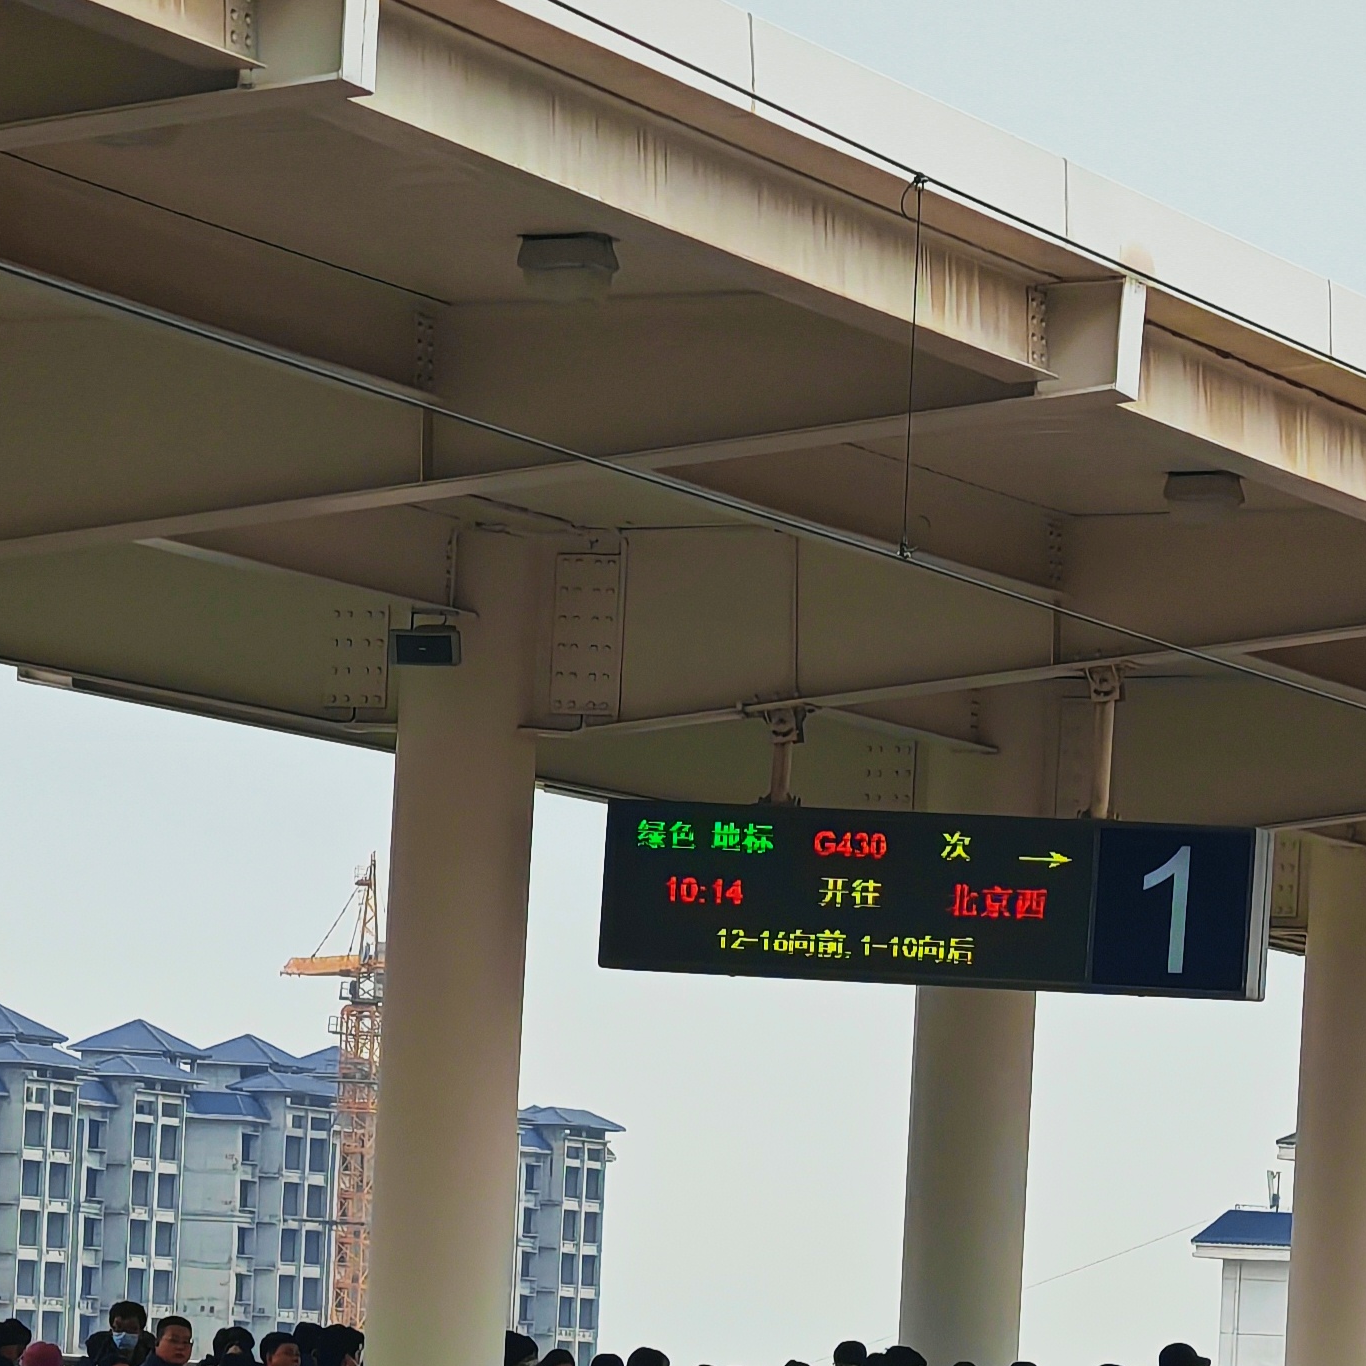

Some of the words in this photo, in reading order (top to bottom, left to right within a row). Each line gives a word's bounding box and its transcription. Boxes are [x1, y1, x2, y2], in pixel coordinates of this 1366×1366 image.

[637, 819, 695, 849] 绿色
[711, 821, 774, 854] 地标
[814, 830, 887, 859] G430
[941, 831, 971, 862] 次
[666, 876, 743, 905] 10:14
[818, 876, 882, 908] 开往
[950, 883, 1048, 920] 北京西
[1143, 846, 1191, 974] 1
